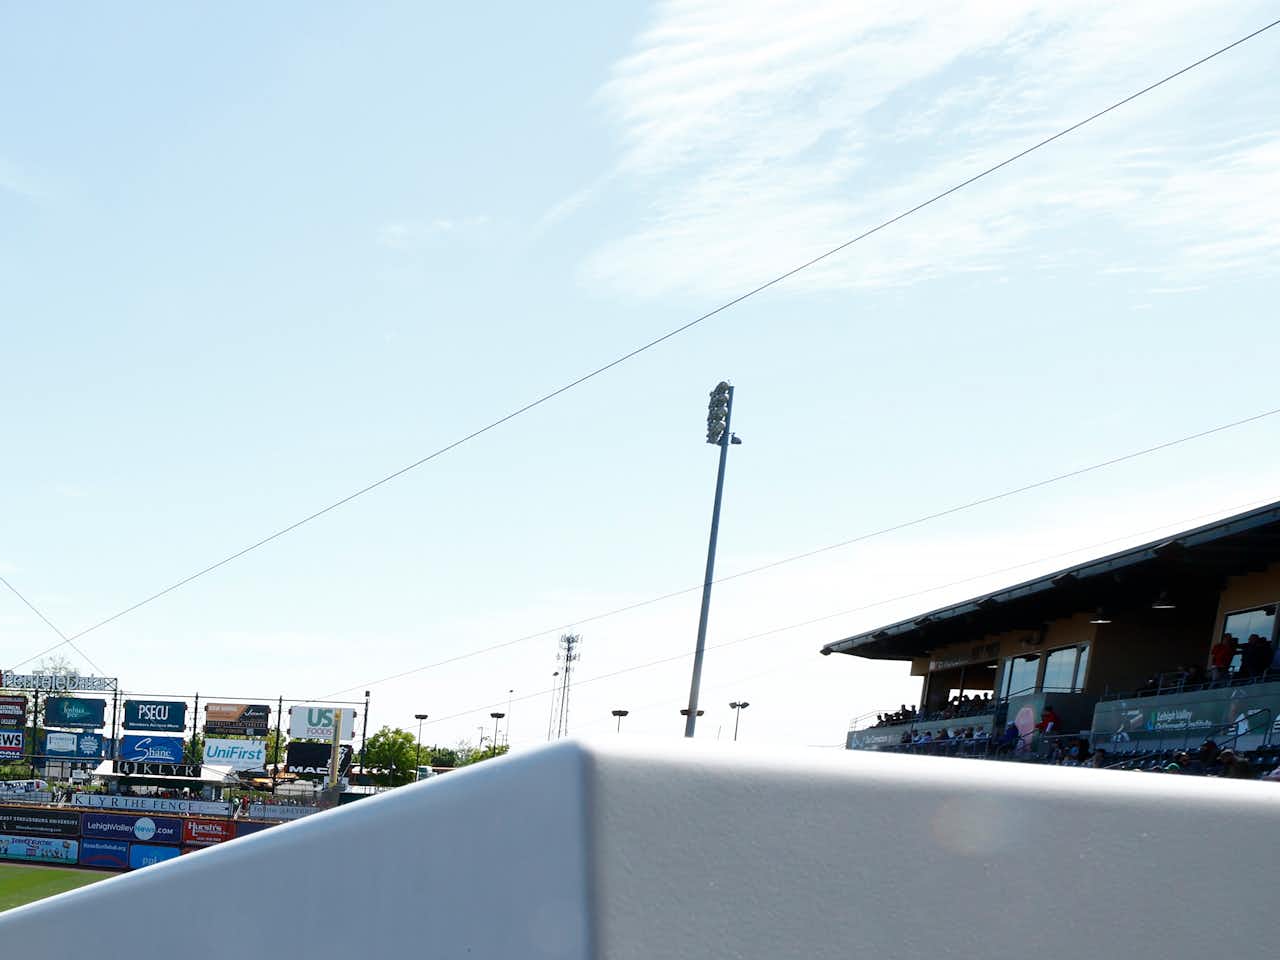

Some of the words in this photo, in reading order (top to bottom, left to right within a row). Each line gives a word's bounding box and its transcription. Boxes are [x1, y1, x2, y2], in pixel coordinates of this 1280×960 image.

[138, 704, 169, 720] PSECU
[206, 745, 262, 760] UniFirst
[124, 799, 139, 808] THE
[153, 800, 193, 811] FENCE
